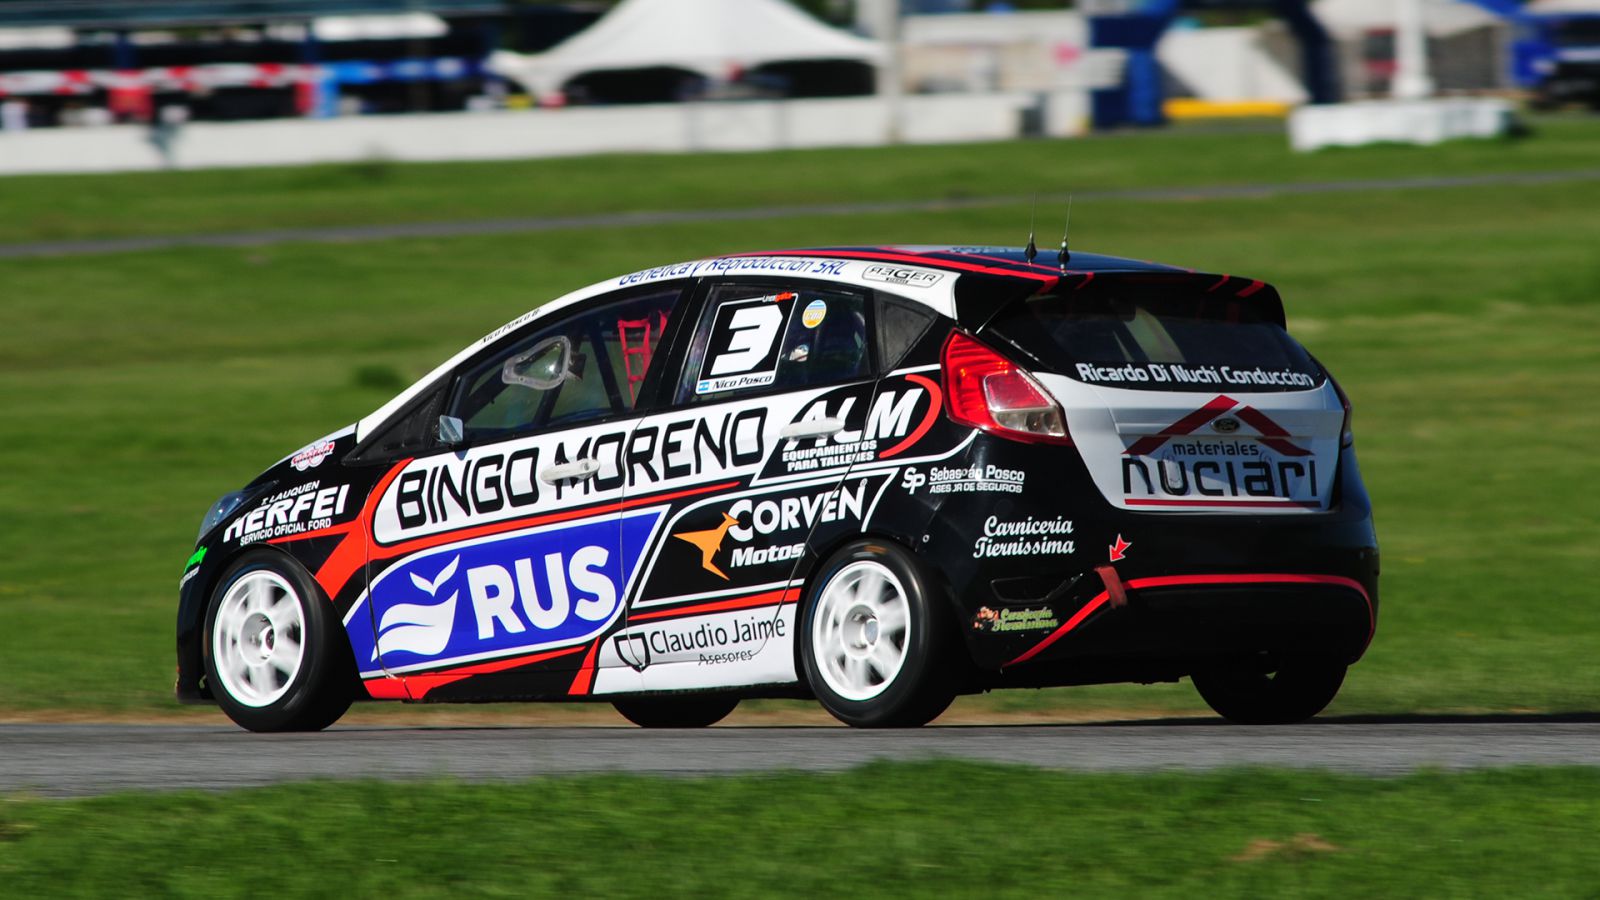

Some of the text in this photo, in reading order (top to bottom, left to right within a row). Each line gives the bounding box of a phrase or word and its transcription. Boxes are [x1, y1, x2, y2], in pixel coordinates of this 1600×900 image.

[812, 259, 847, 276] SRL
[710, 304, 783, 376] 3
[713, 375, 773, 390] Nico Posco
[1076, 362, 1315, 387] Ricardo Di Nuchi Conduccion
[783, 388, 924, 451] ALM
[782, 440, 877, 462] EQUIPAMIENTOS
[1172, 441, 1260, 456] materiales
[396, 407, 768, 530] BINGO MORENO
[787, 451, 875, 472] PARA TALLERES
[985, 464, 1025, 481] Posco
[269, 480, 320, 503] LAUQUEN
[963, 482, 976, 492] DE
[976, 482, 1023, 494] SEGUROS
[240, 517, 332, 546] SERVICIO OFICIAL FORD
[983, 515, 1074, 537] Carniceria
[730, 542, 806, 568] Motos
[973, 536, 1075, 559] Tiernissima
[467, 545, 616, 640] RUS
[650, 616, 786, 655] Claudio Jaime
[698, 649, 754, 666] Asesores
